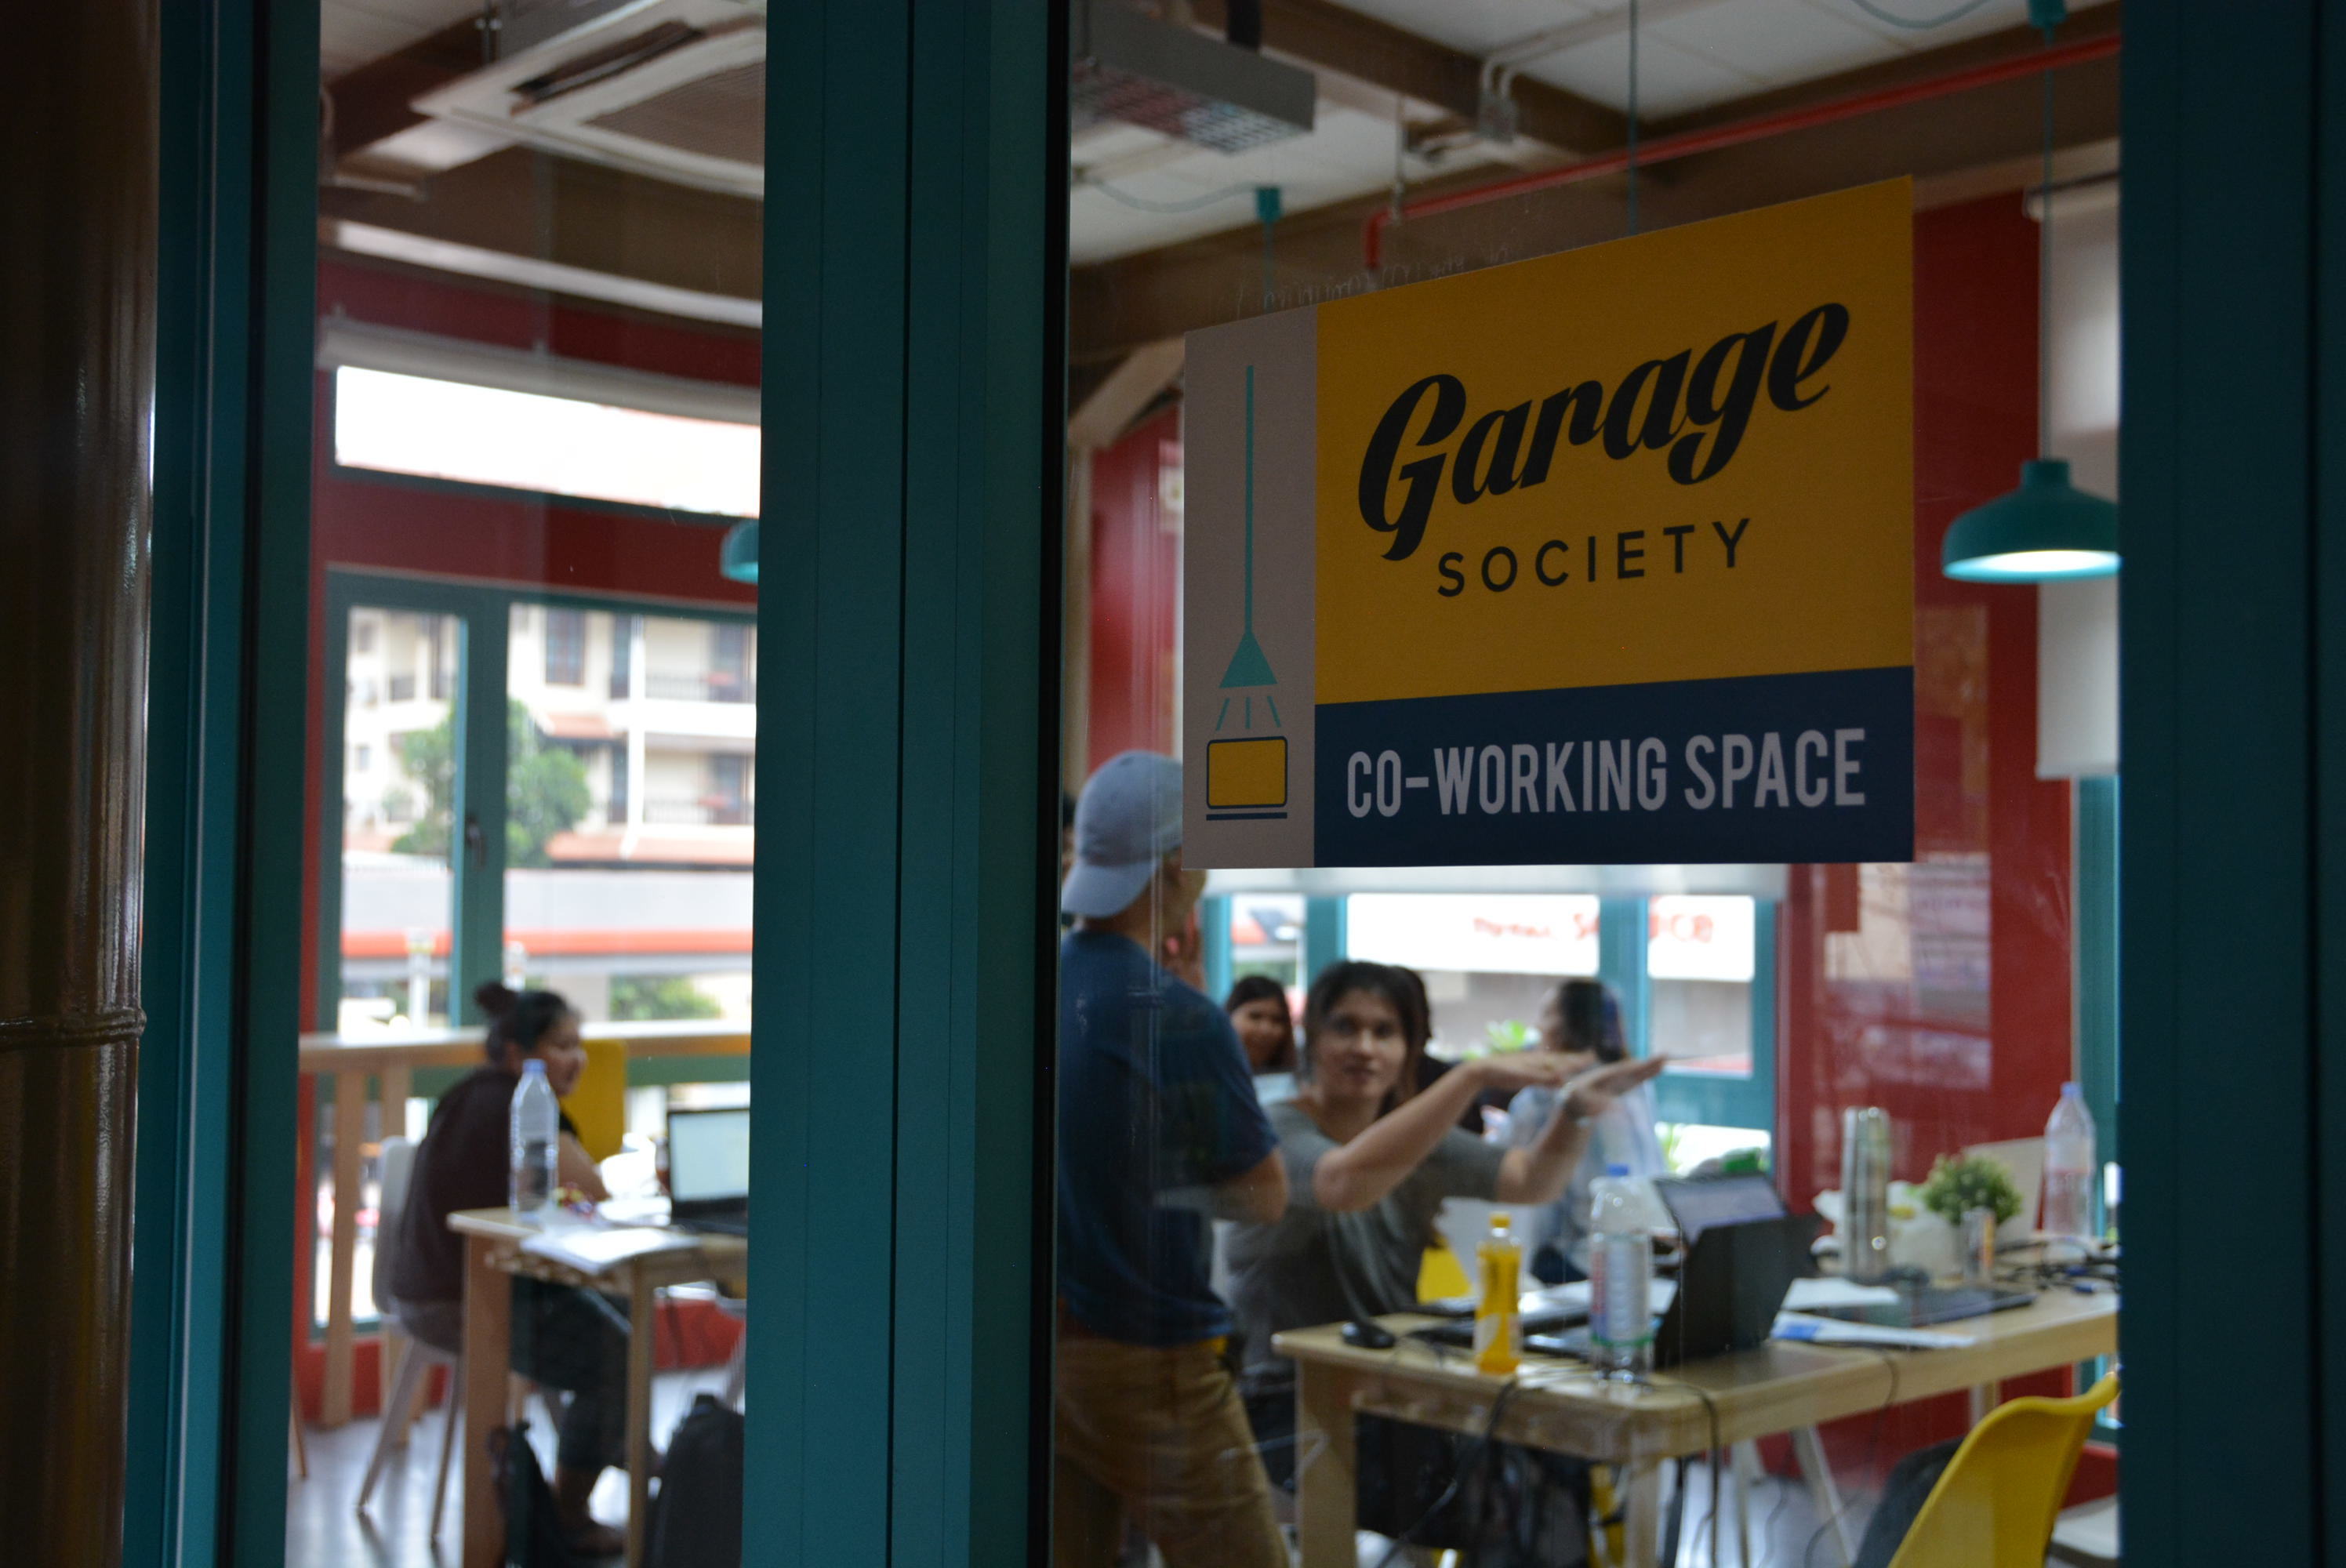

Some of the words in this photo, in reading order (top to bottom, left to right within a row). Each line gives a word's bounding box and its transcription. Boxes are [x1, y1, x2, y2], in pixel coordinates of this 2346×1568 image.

[1358, 302, 1850, 561] Garage
[1437, 518, 1750, 597] SOCIETY
[1347, 737, 1667, 818] CO-WORKING
[1684, 728, 1865, 809] SPACE
